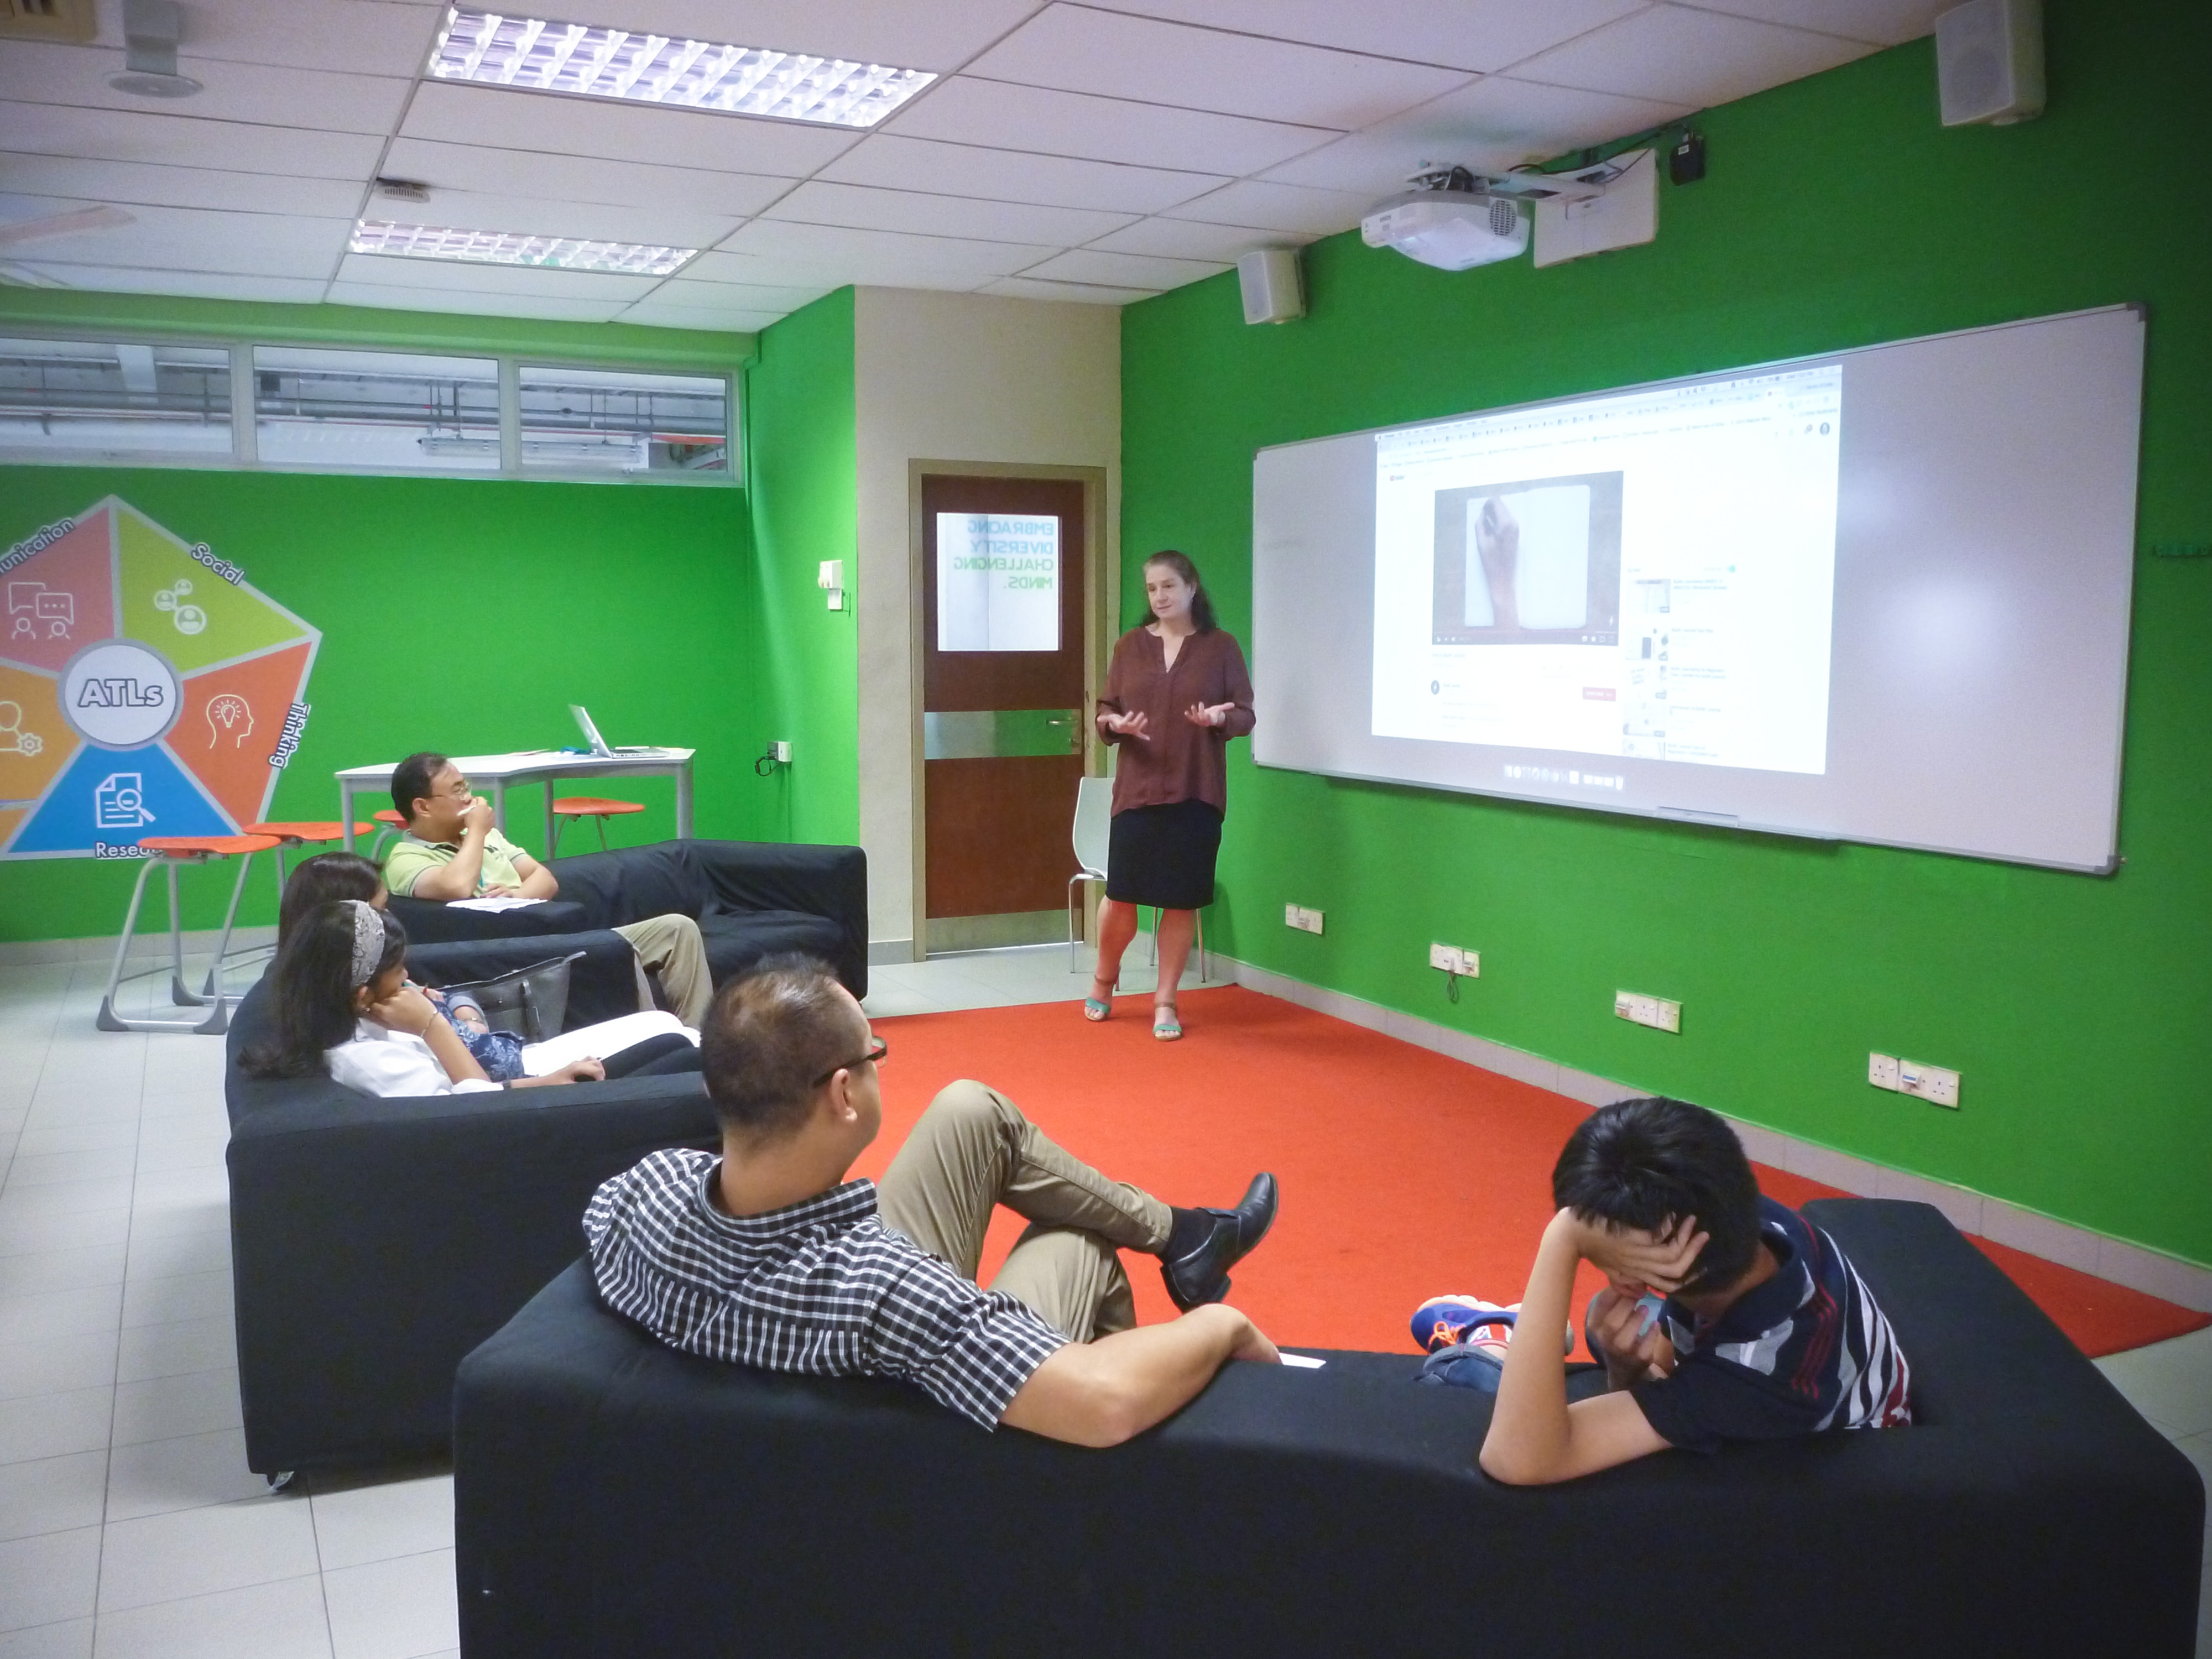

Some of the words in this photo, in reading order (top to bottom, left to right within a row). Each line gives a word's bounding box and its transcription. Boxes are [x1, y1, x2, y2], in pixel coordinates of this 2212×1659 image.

[190, 543, 246, 586] Social
[77, 679, 164, 707] ATLs
[268, 703, 309, 769] Thinking
[95, 841, 149, 858] Resea
